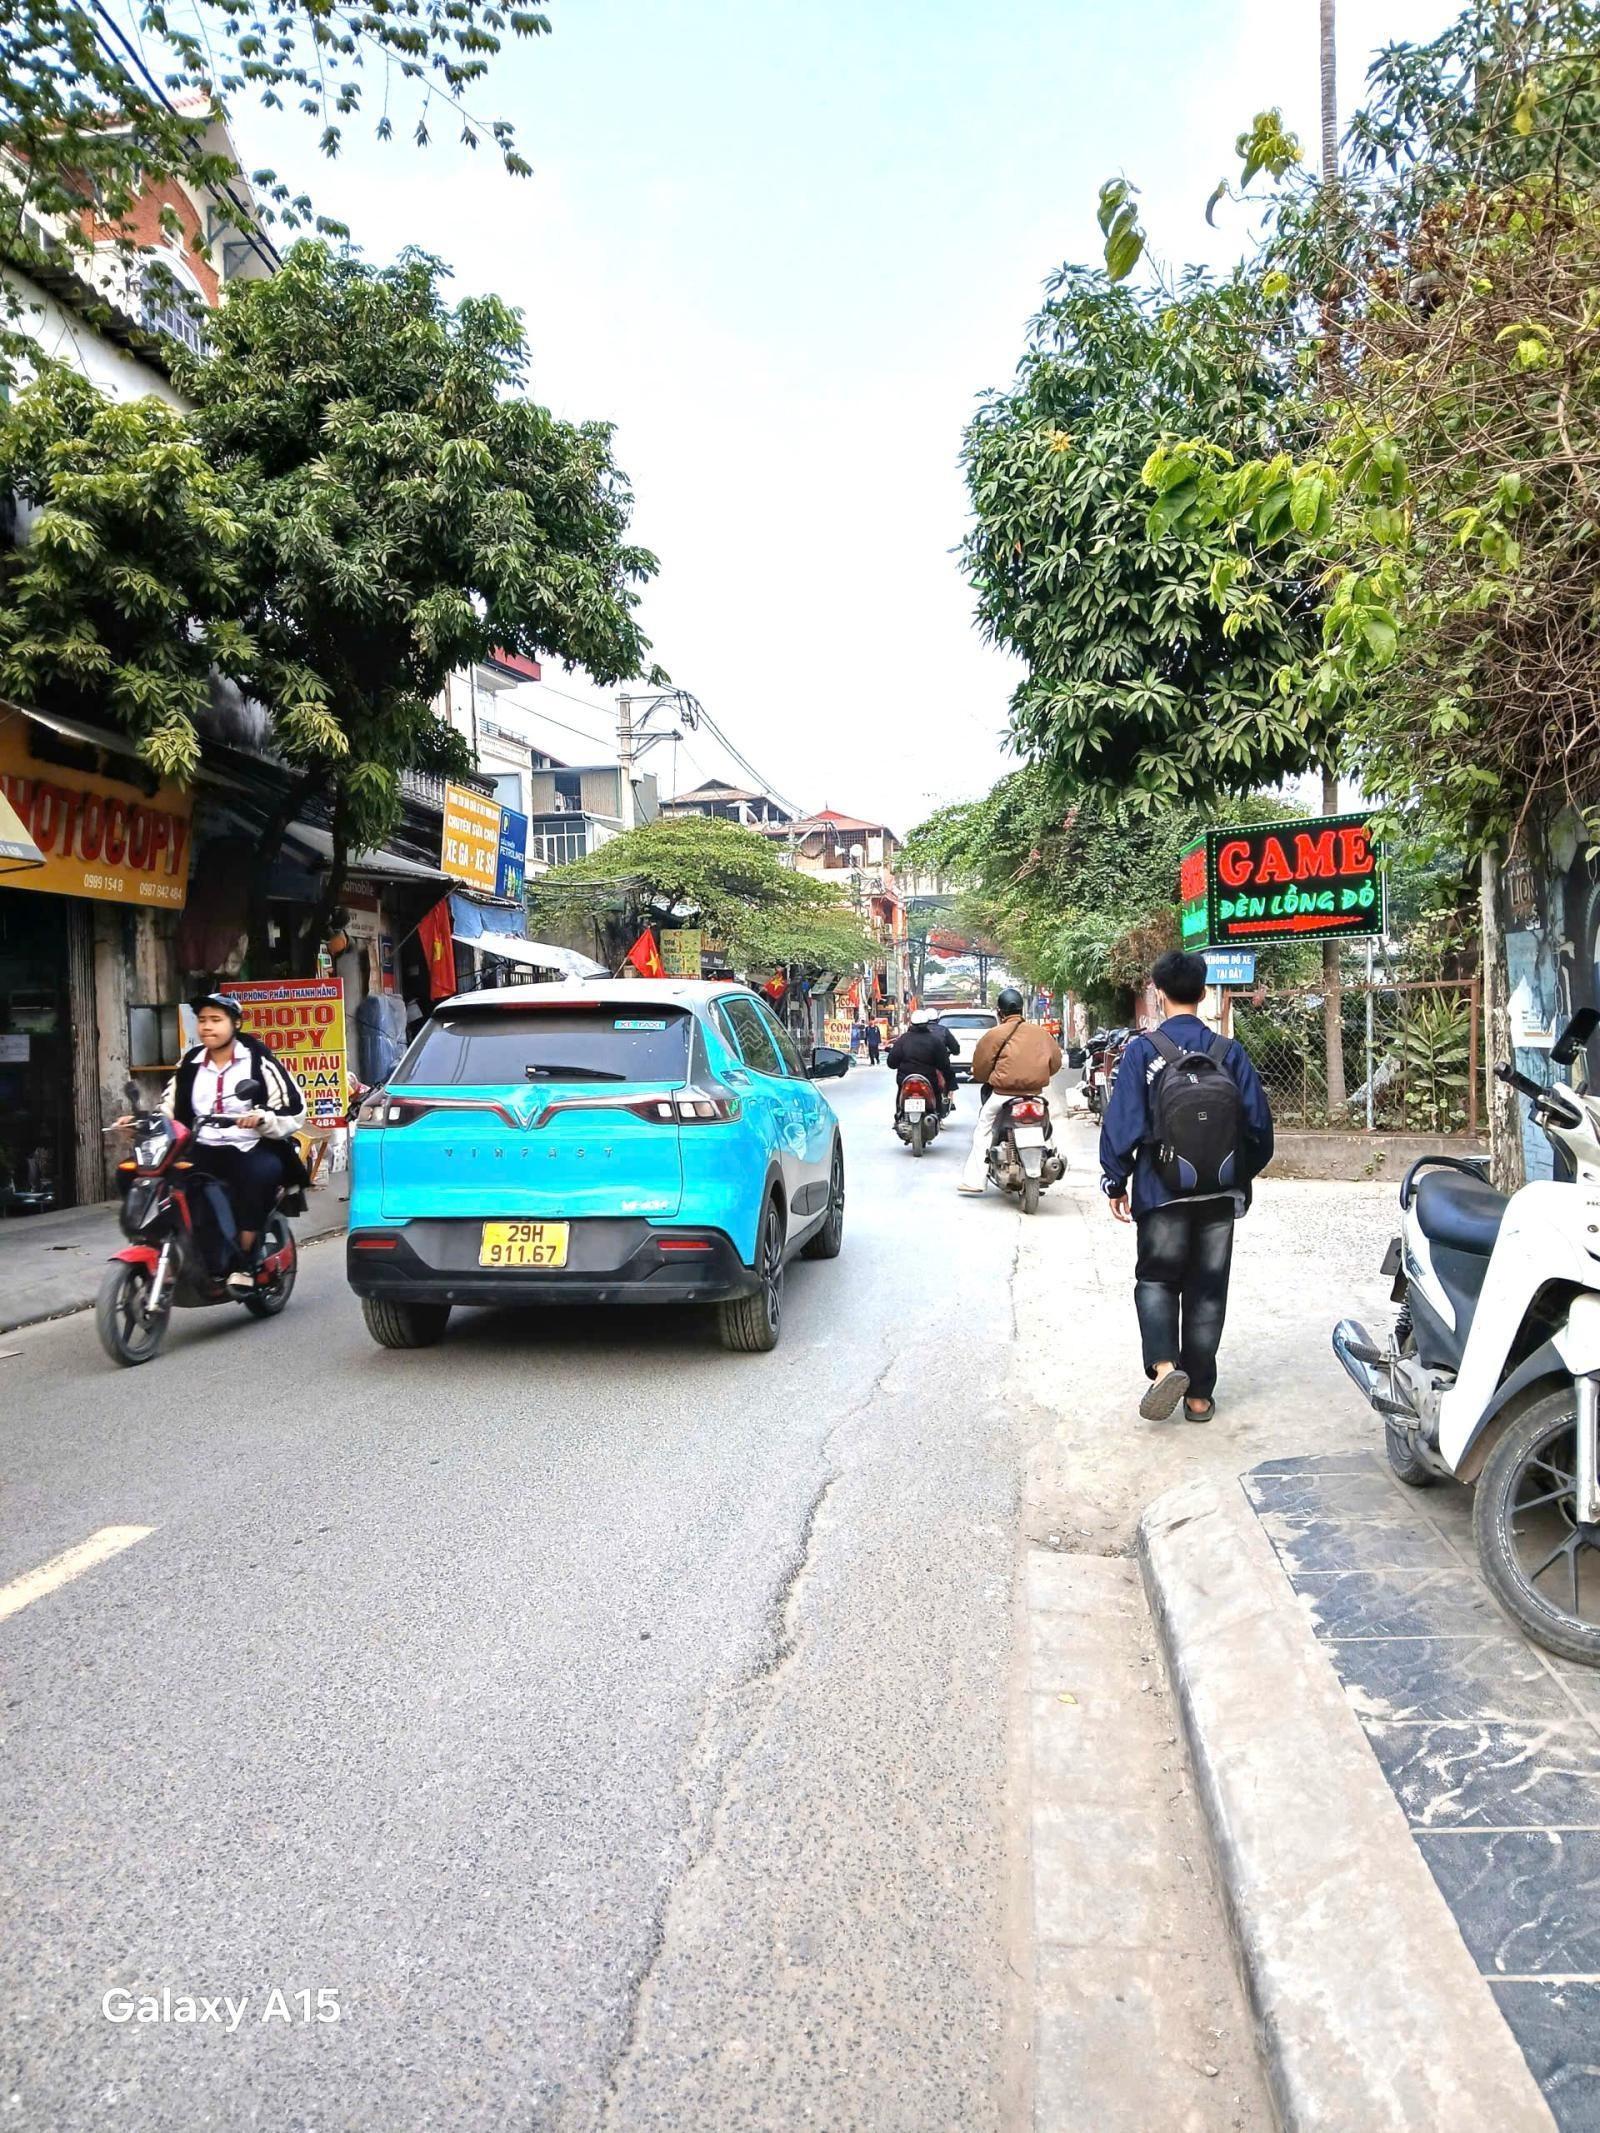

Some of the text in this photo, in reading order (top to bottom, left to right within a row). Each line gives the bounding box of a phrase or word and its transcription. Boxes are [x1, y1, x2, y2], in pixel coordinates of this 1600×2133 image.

[0, 775, 188, 875] HOTOCOPY
[446, 838, 457, 864] XE
[458, 842, 469, 867] GA
[474, 847, 485, 872] XE
[1219, 828, 1374, 886] GAME
[1220, 892, 1265, 919] ĐÈN
[1271, 883, 1335, 914] LỒNG
[1341, 880, 1375, 910] ĐỎ
[291, 989, 315, 998] THANH
[303, 1053, 340, 1071] MÀU
[444, 1148, 614, 1158] VINFAST
[507, 1225, 543, 1243] 29H
[490, 1245, 556, 1263] 911.67
